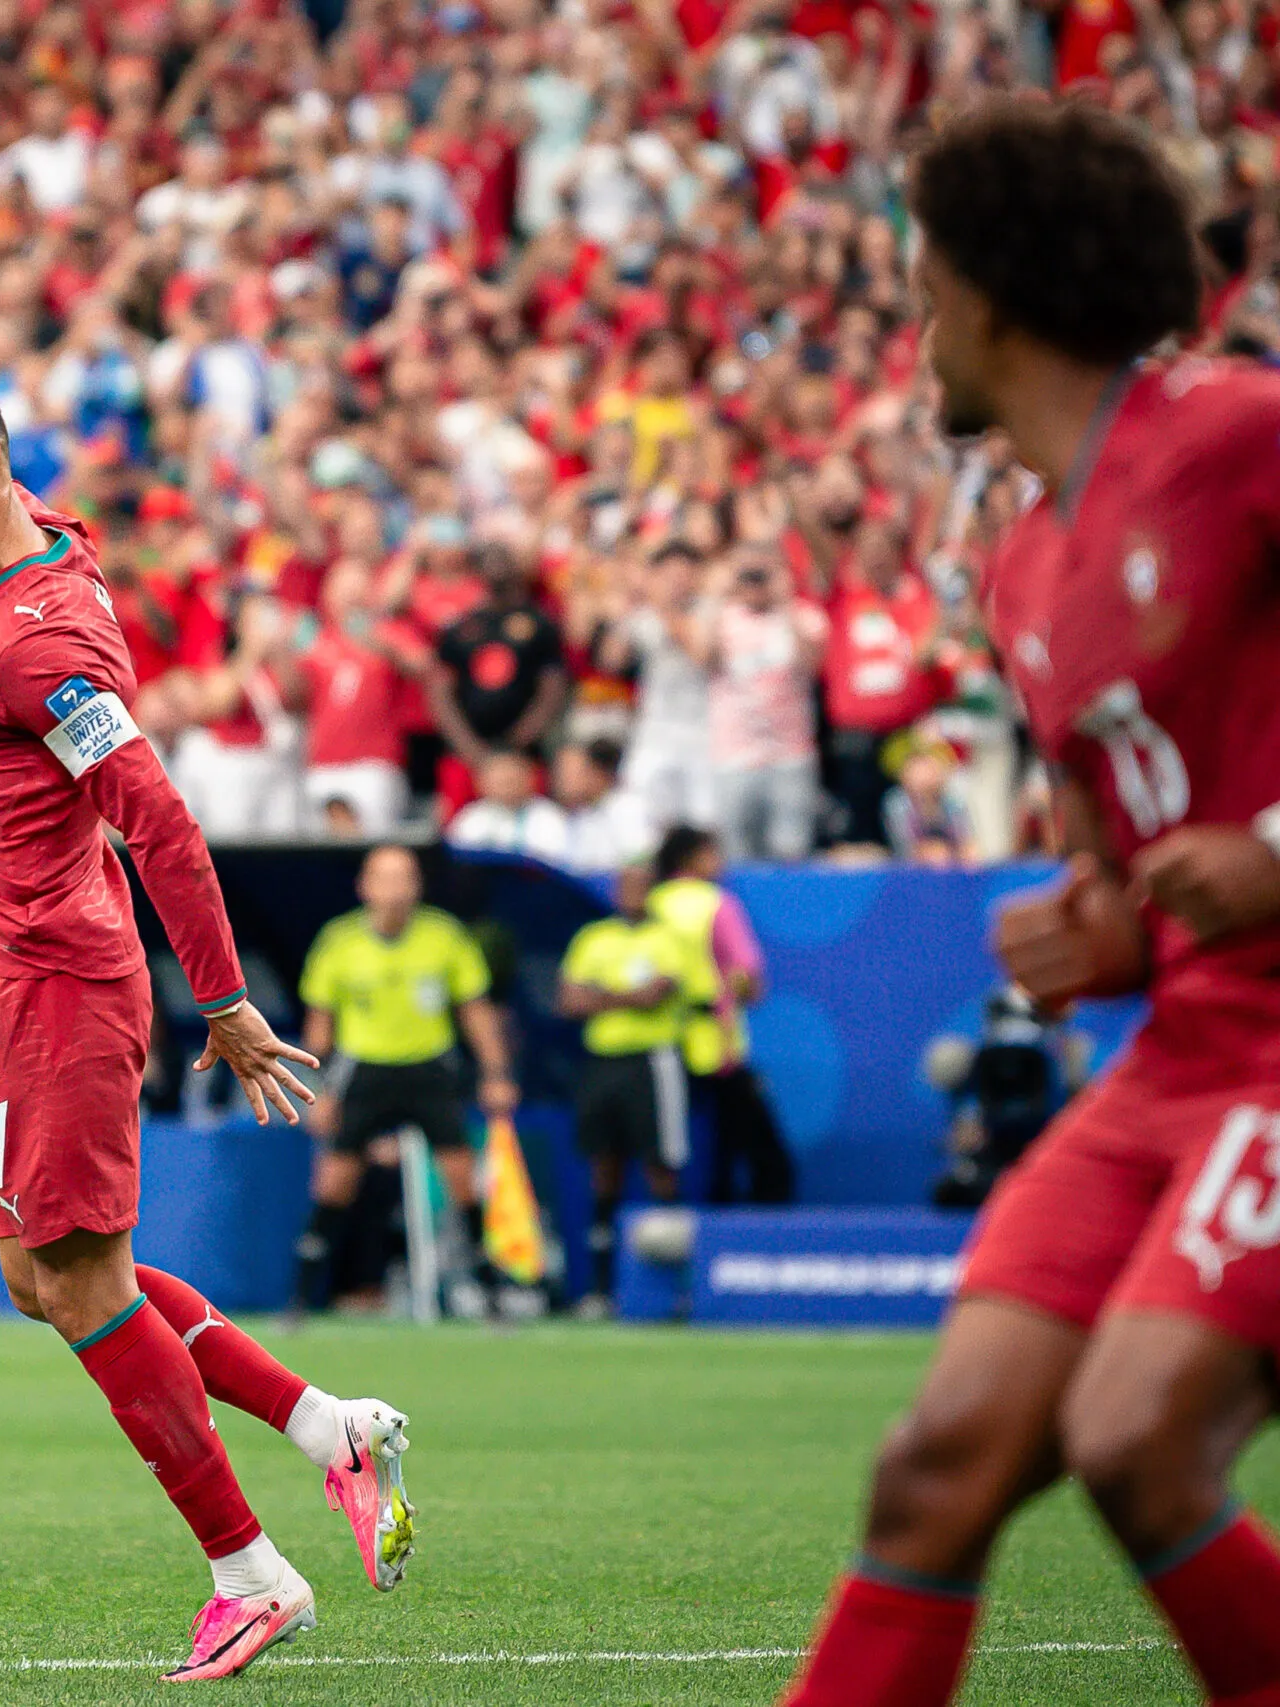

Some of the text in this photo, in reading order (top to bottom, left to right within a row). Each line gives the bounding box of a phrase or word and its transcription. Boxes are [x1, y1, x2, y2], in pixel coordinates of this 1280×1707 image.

[62, 701, 108, 736] FOOTBALL
[69, 708, 113, 747] UNITES
[89, 718, 123, 747] World
